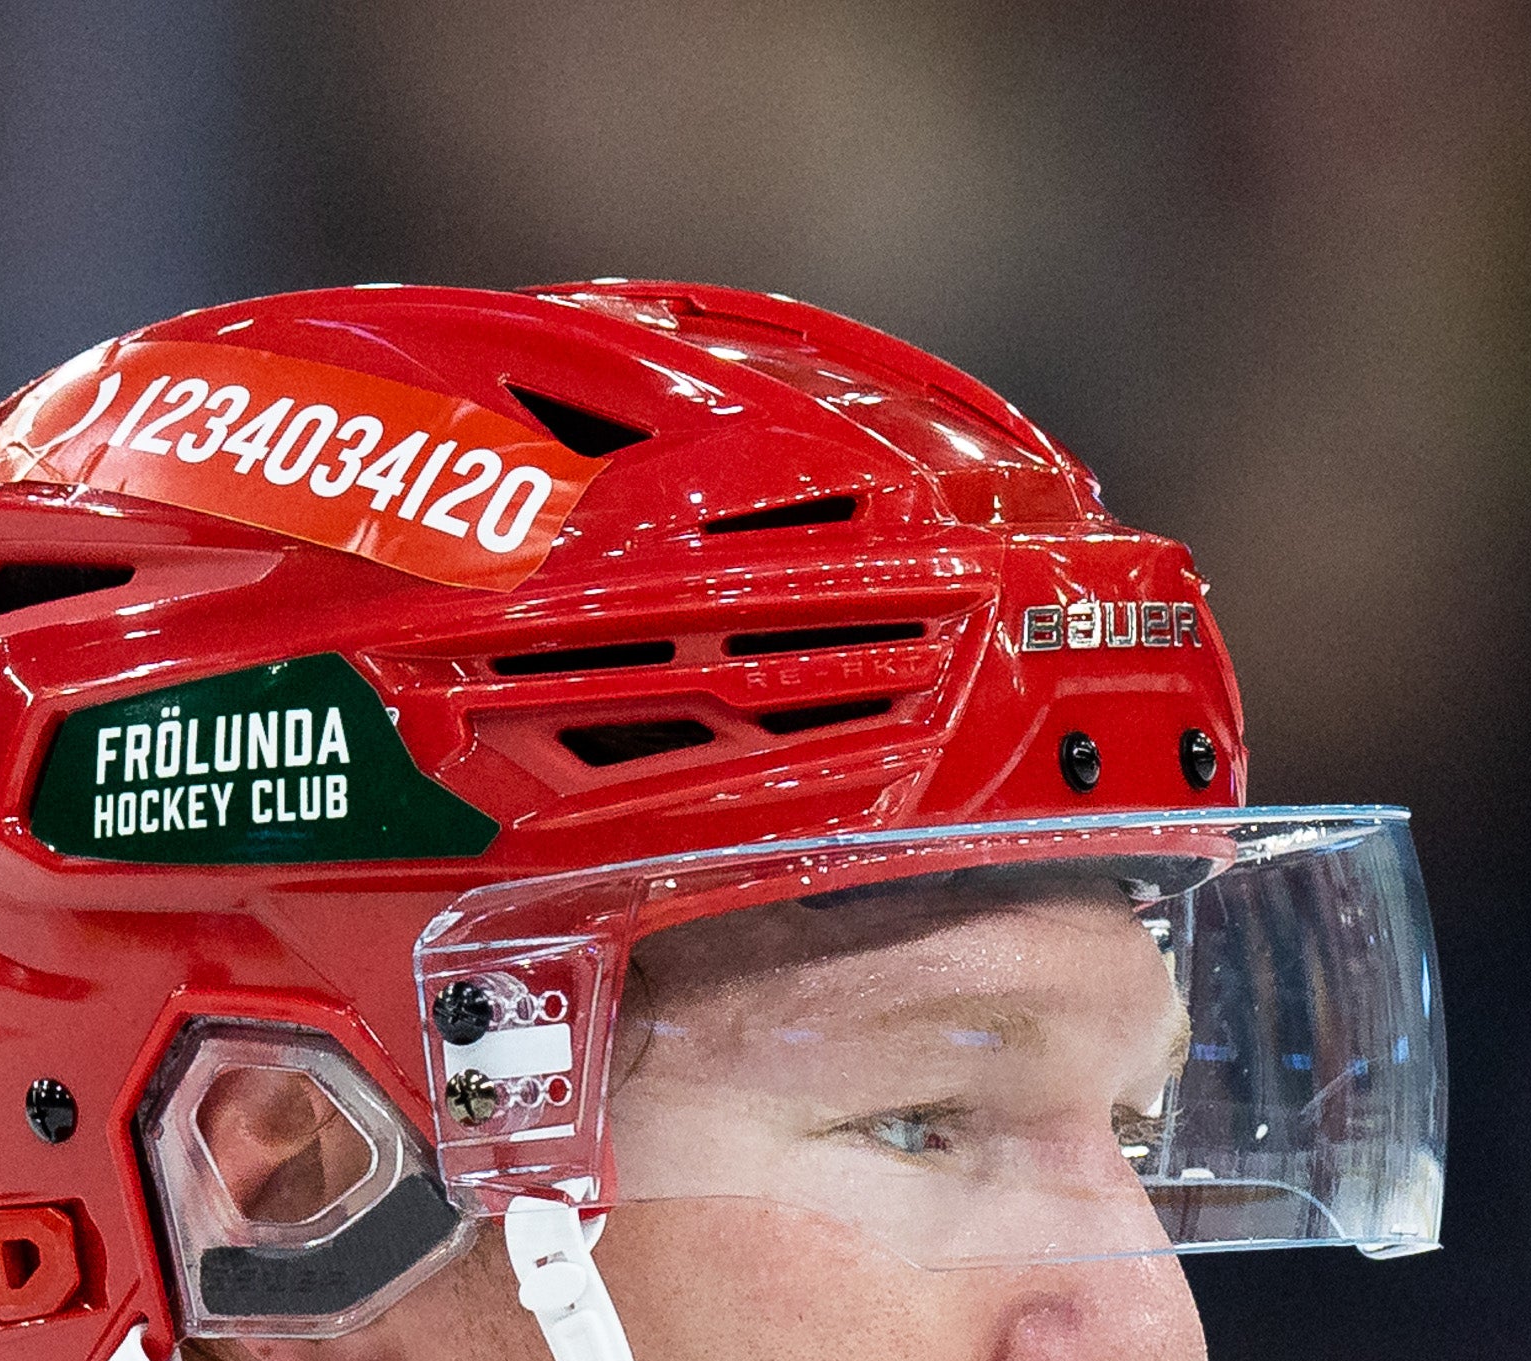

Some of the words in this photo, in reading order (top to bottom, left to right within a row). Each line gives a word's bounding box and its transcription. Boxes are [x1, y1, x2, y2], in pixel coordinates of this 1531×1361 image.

[108, 374, 553, 554] 1234034120
[1021, 601, 1202, 653] BAUER
[96, 706, 350, 785] FRÖLUNDA
[93, 782, 234, 839] HOCKEY
[251, 774, 349, 823] CLUB
